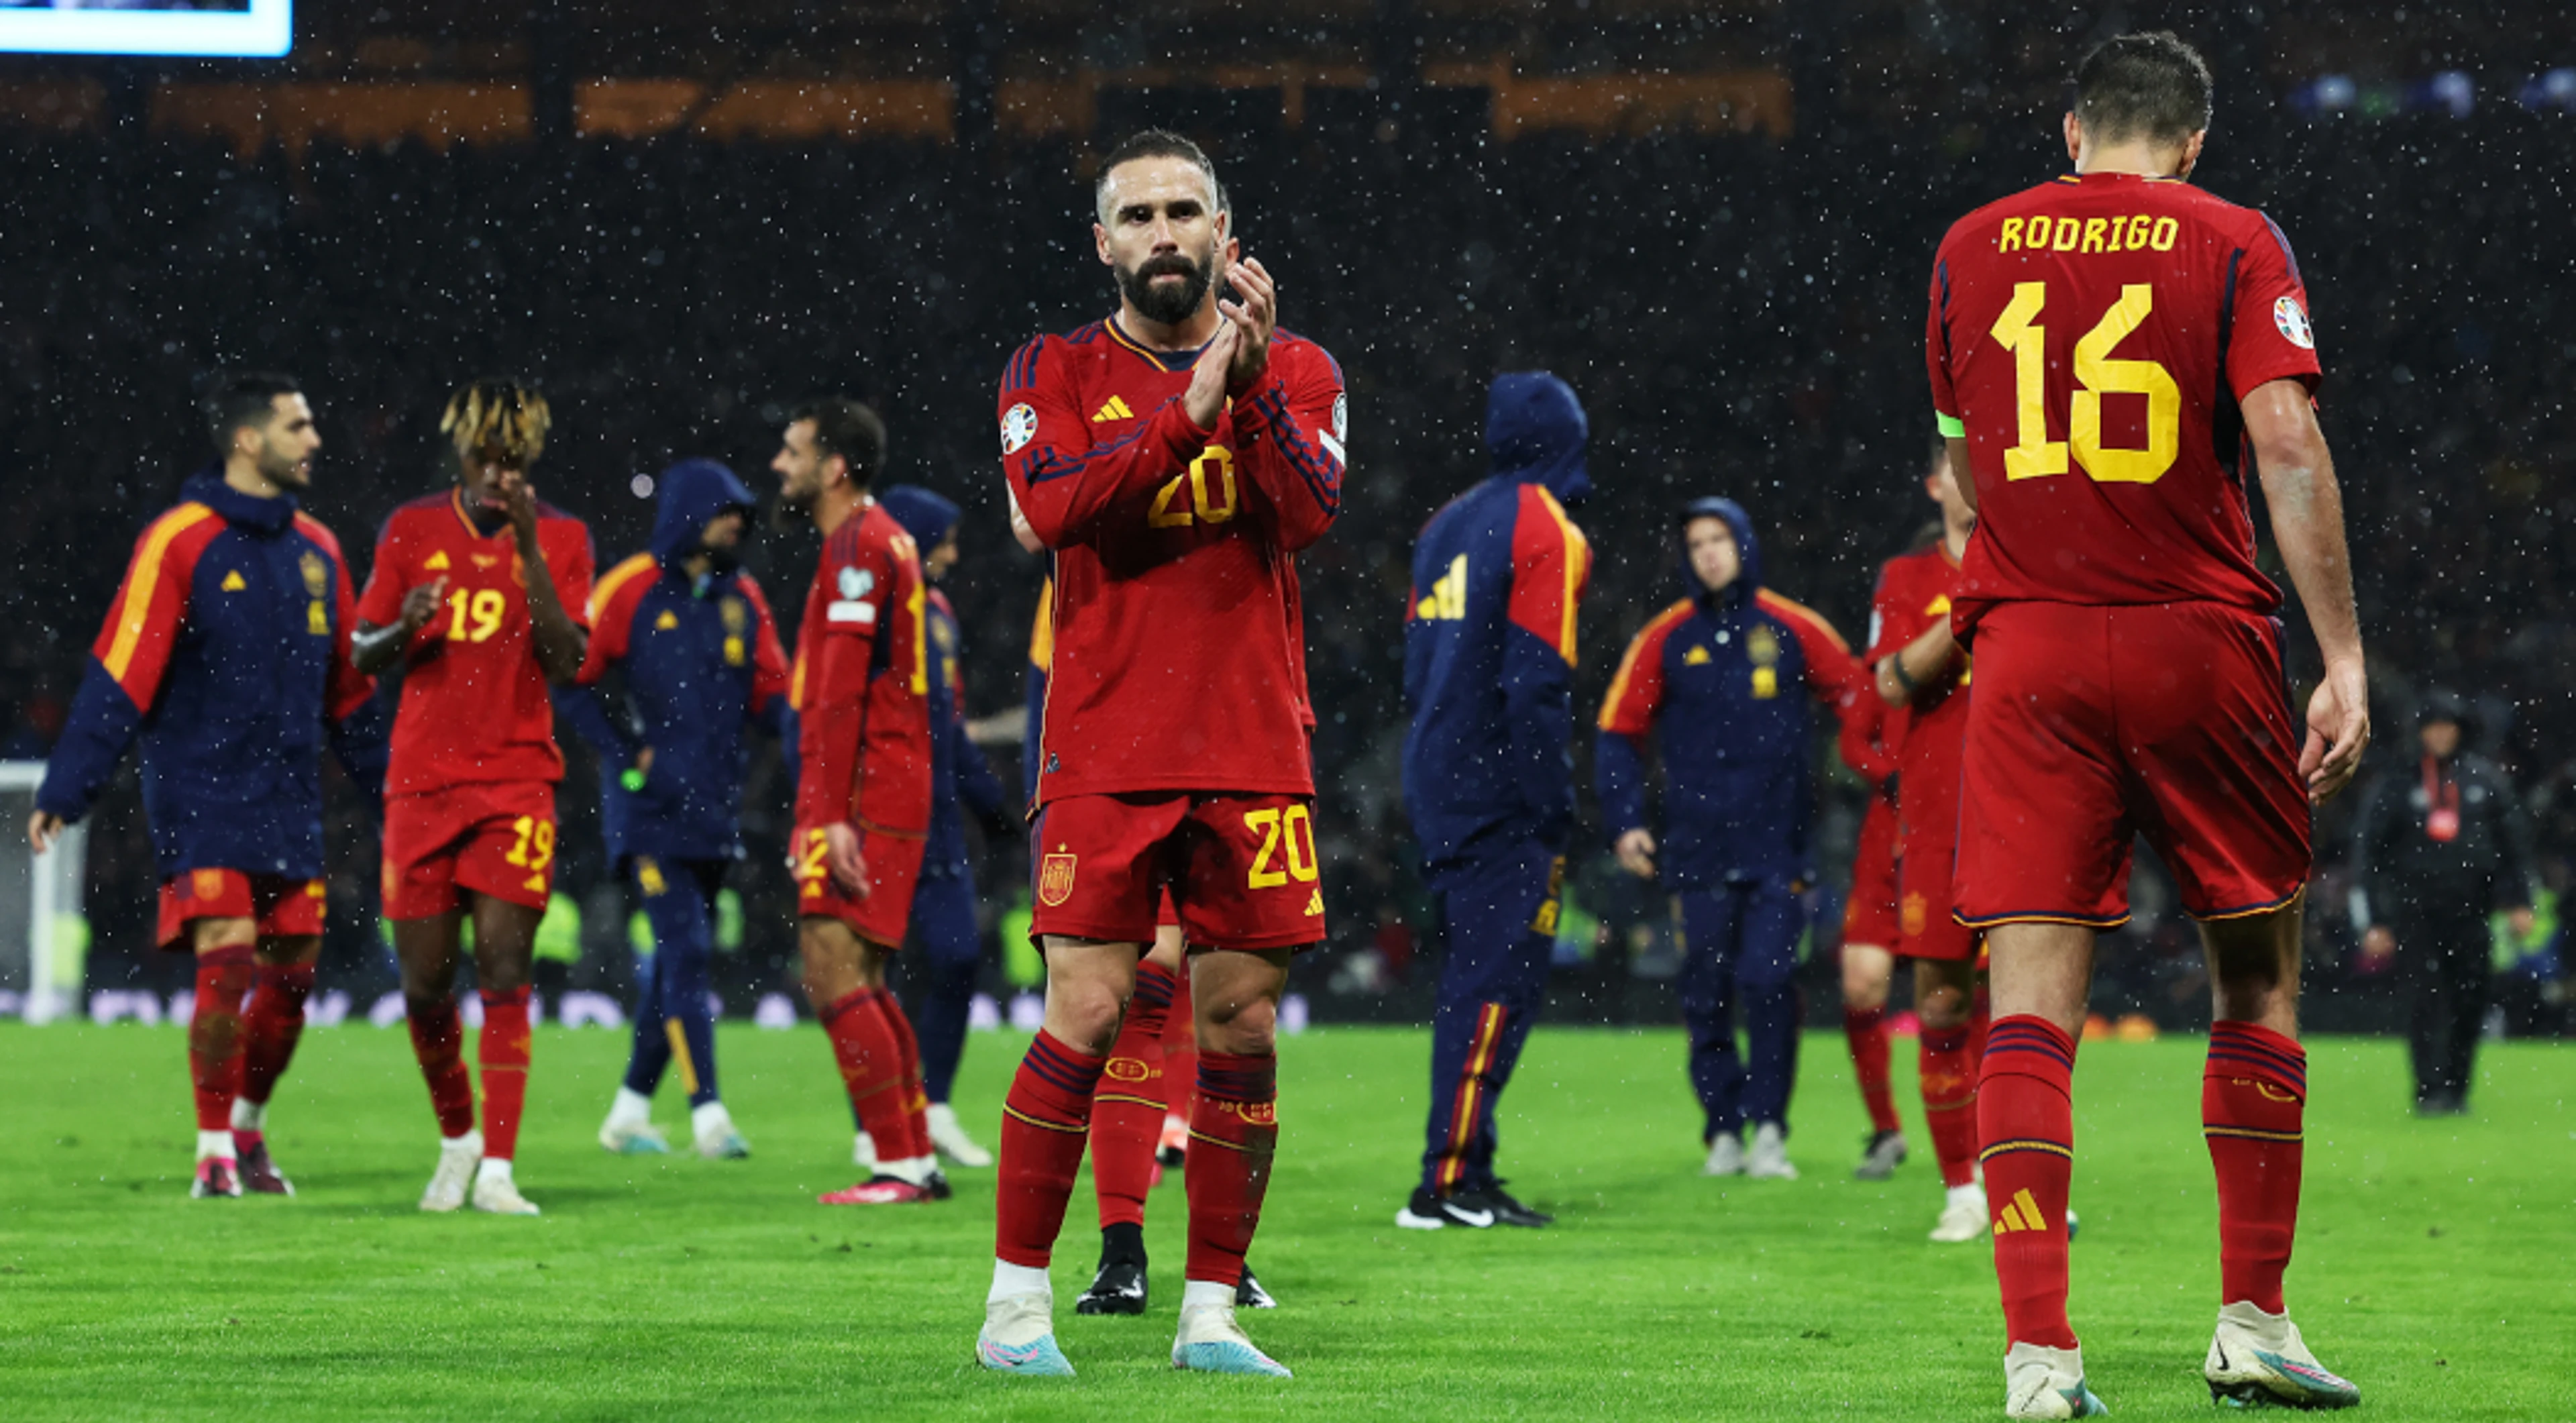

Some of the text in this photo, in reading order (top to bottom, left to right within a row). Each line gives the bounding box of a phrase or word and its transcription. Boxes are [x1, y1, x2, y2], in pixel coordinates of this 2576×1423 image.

[1999, 215, 2179, 253] RODRIGO
[1990, 281, 2181, 484] 16
[1148, 444, 1237, 528] 20
[447, 587, 506, 642] 19
[506, 814, 555, 871] 19
[1244, 803, 1318, 889] 20
